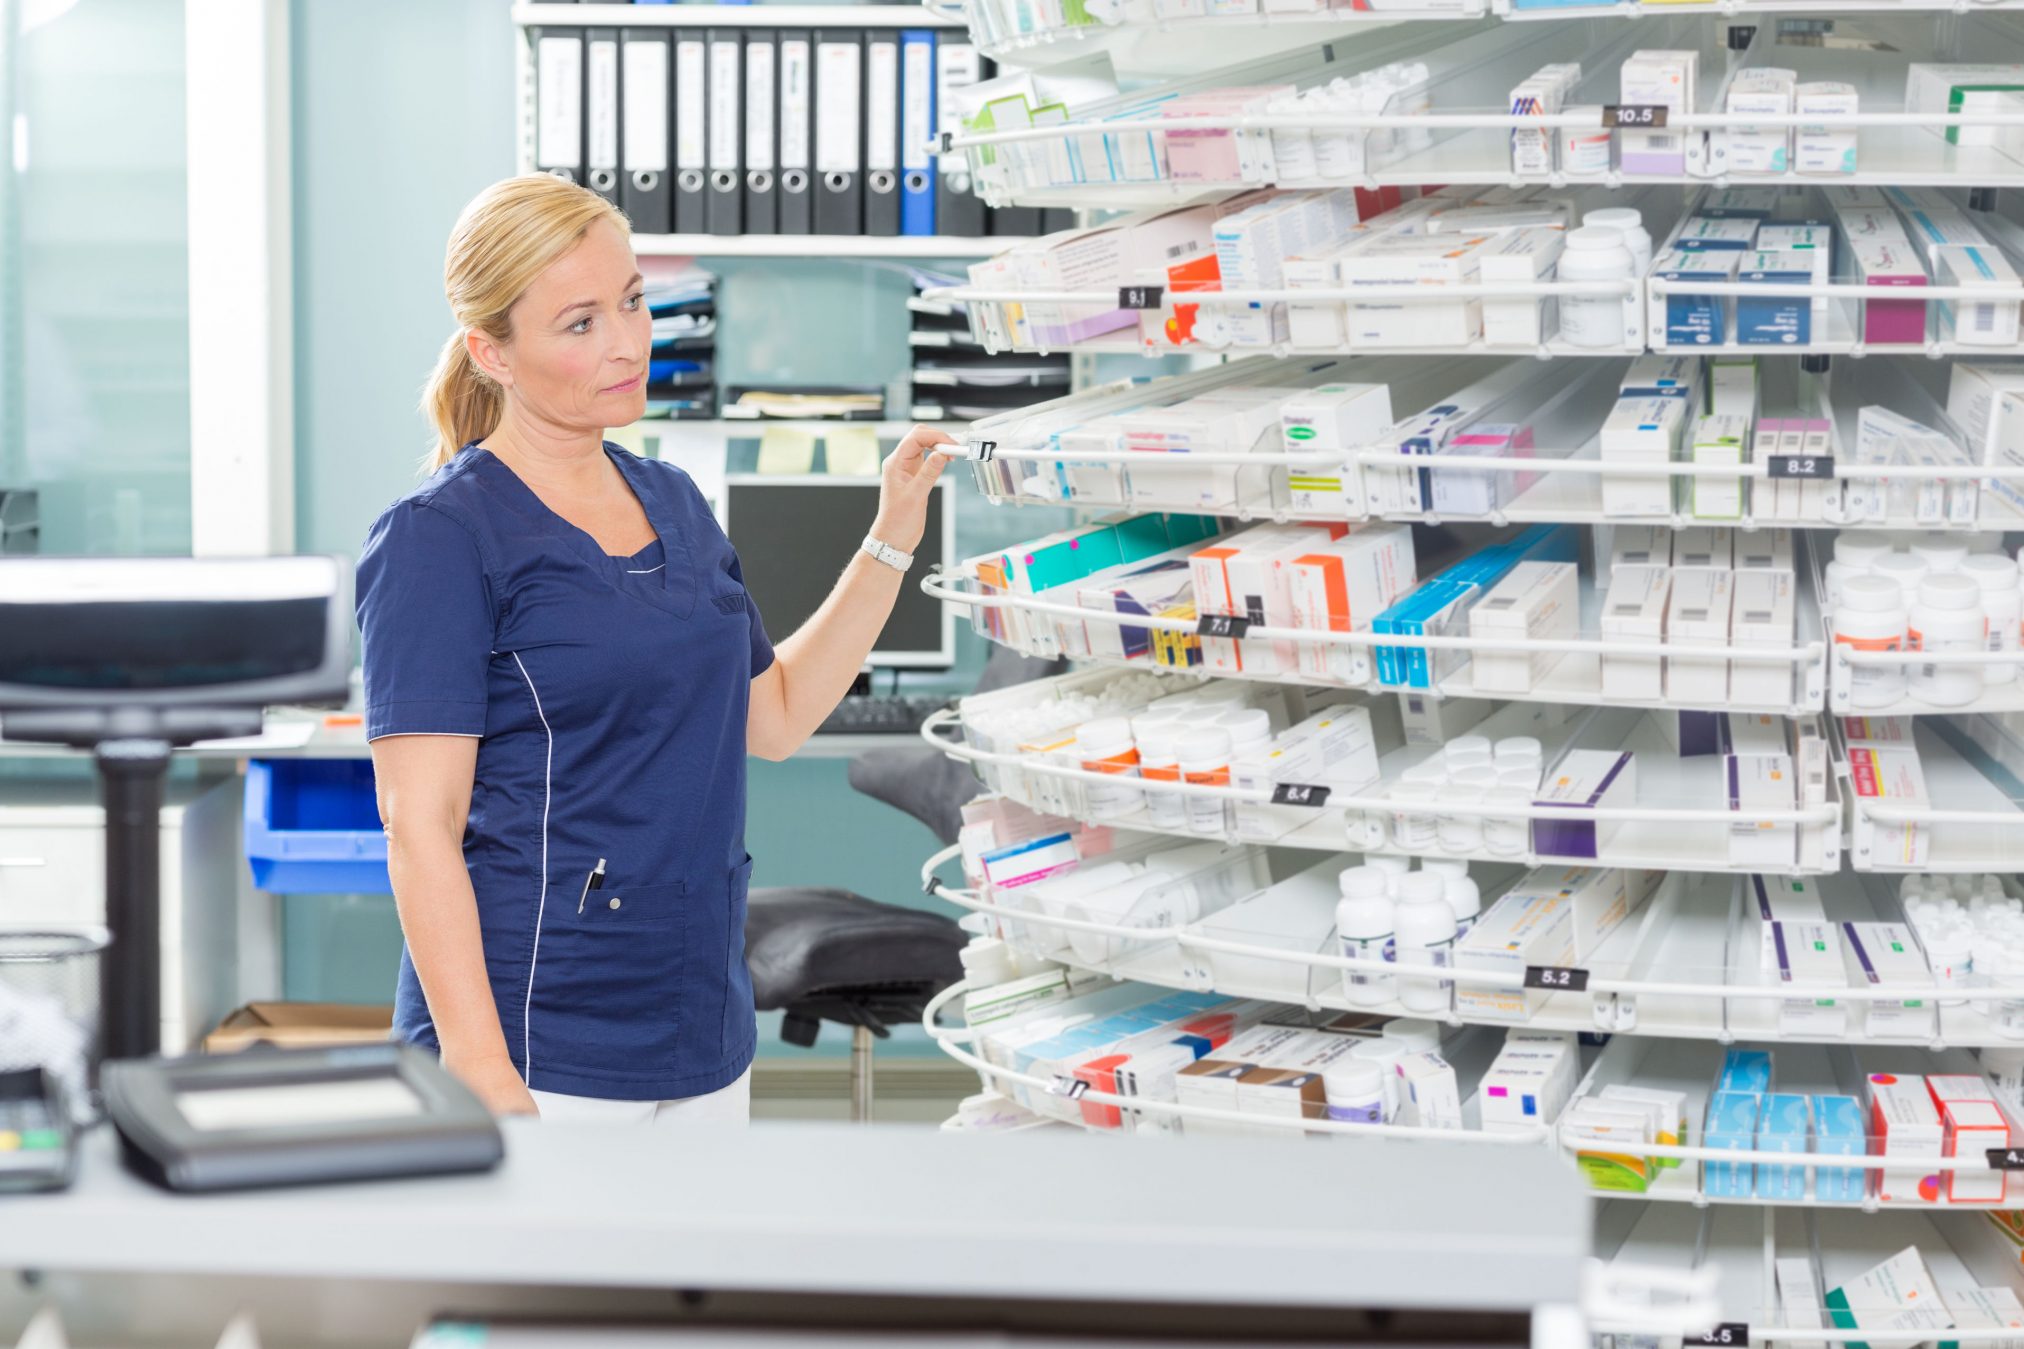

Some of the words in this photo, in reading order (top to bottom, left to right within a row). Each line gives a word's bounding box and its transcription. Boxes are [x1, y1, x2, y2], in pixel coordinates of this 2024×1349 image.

[1617, 108, 1653, 123] 10.5
[1788, 460, 1815, 473] 8.2
[1212, 618, 1231, 633] 7.1
[1287, 787, 1310, 800] 6.4
[1542, 970, 1570, 985] 5.2
